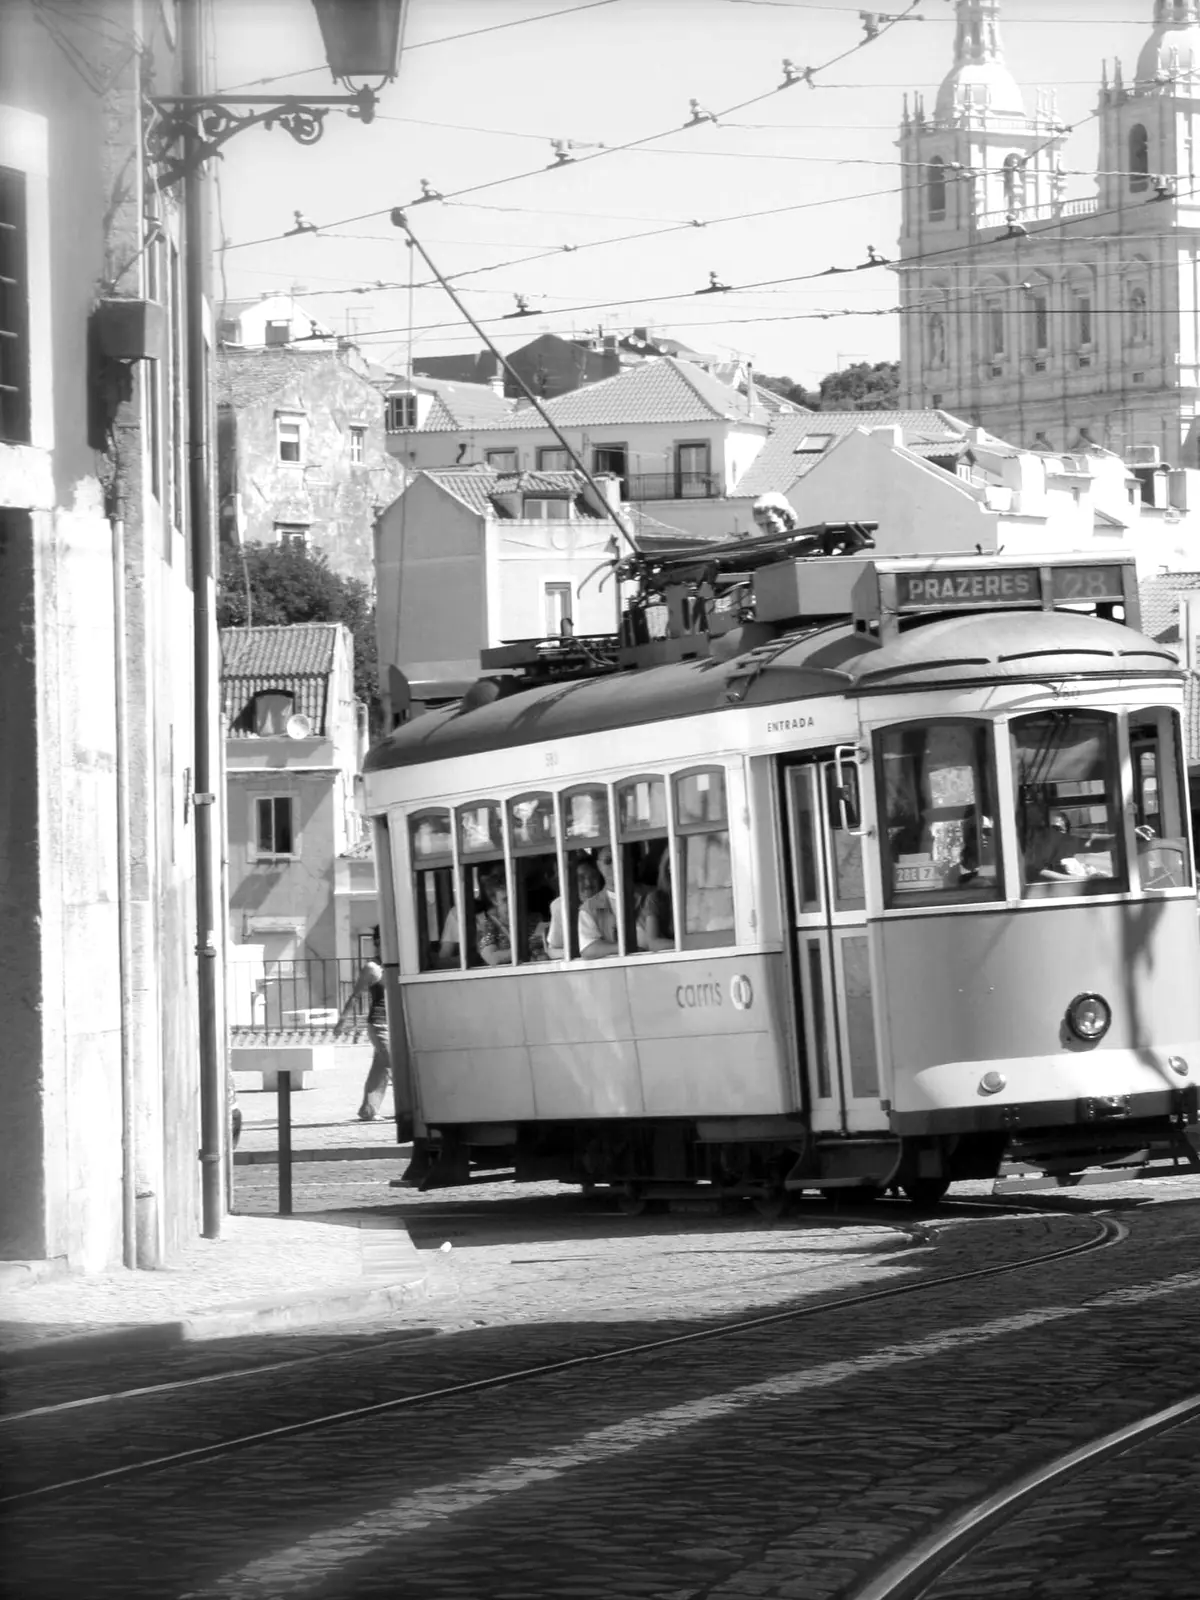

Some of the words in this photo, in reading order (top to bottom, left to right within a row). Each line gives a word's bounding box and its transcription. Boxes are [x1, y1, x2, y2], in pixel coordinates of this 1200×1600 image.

[908, 573, 1030, 600] PRAZERES
[1061, 571, 1108, 597] 28
[767, 716, 815, 733] ENTRADA
[923, 868, 932, 878] 7
[675, 972, 723, 1009] carris
